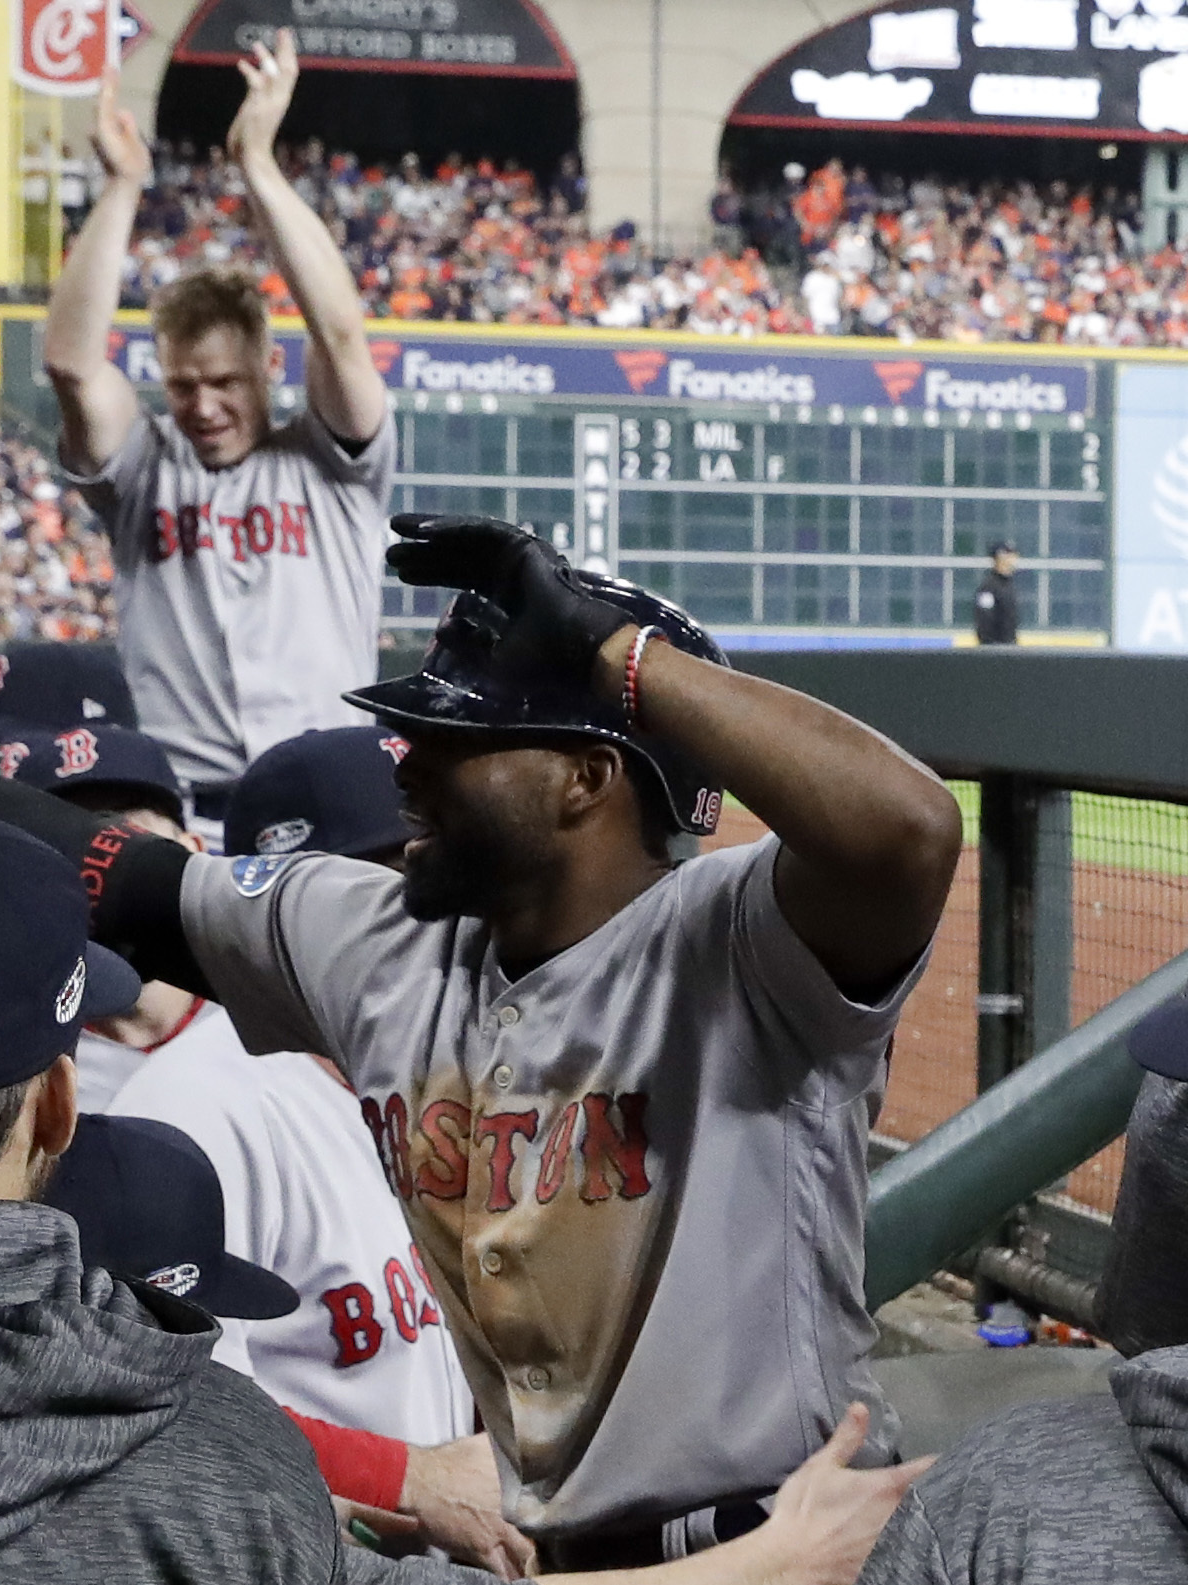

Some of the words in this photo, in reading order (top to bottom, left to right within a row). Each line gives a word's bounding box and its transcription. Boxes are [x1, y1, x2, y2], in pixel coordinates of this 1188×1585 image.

[403, 349, 555, 394] Fanatics
[668, 359, 815, 403] Fanatics
[925, 369, 1067, 412] Fanatics
[694, 421, 743, 451] MIL
[699, 453, 737, 482] LA
[54, 728, 99, 778] B
